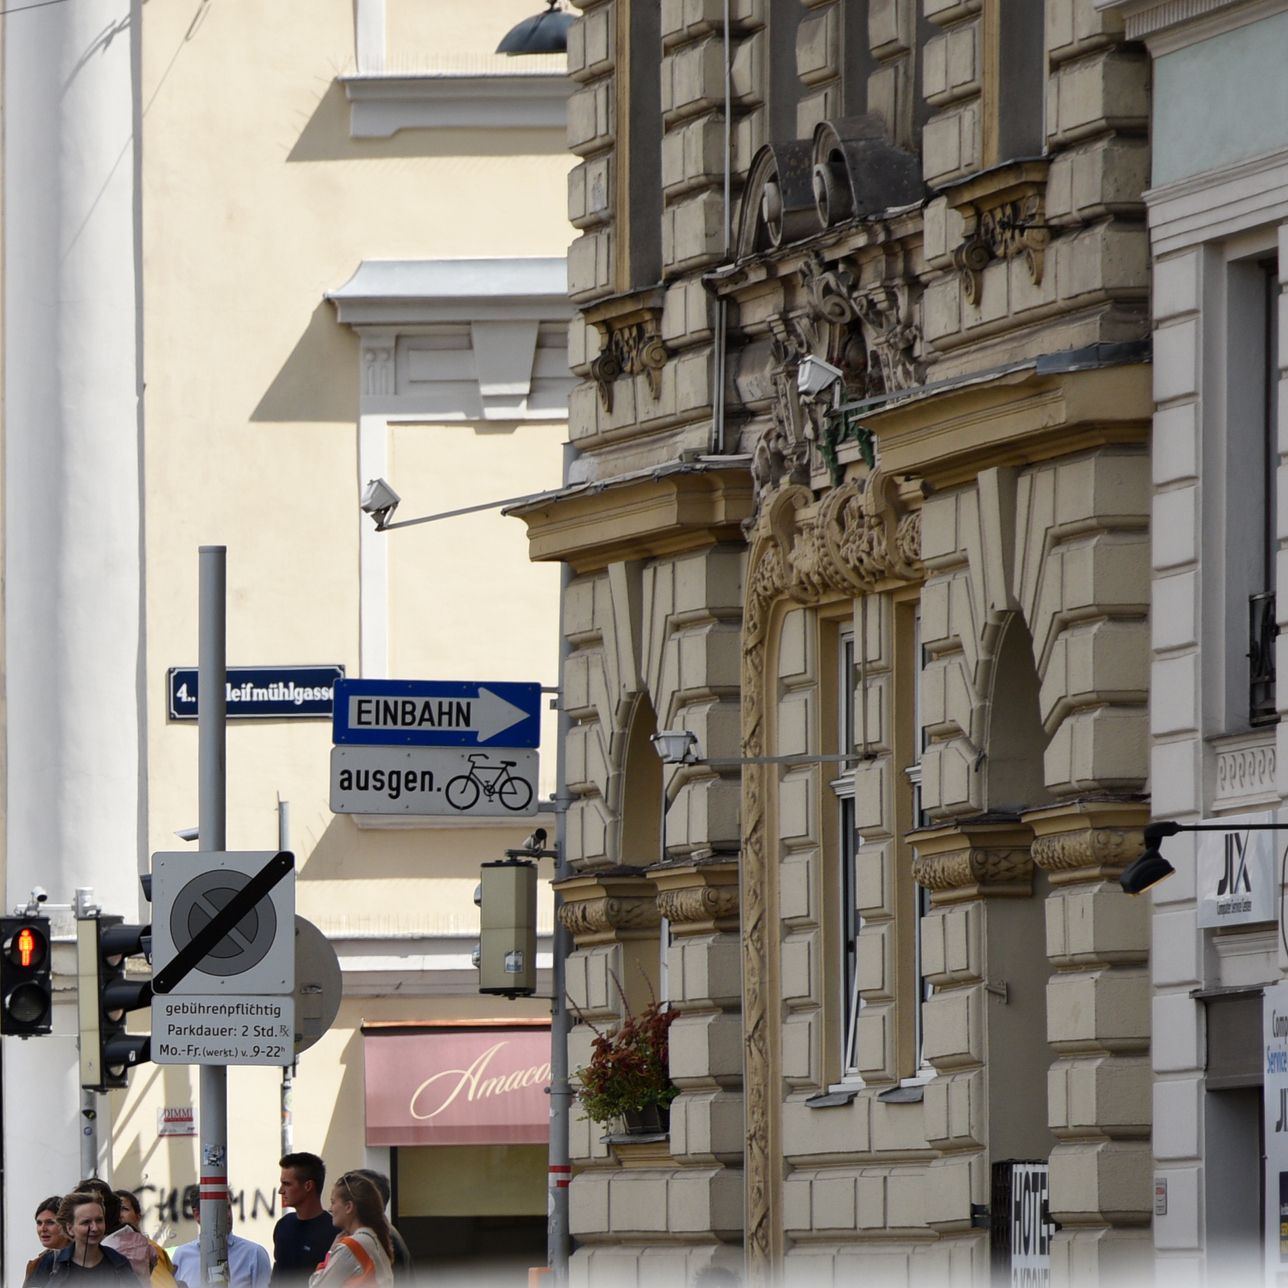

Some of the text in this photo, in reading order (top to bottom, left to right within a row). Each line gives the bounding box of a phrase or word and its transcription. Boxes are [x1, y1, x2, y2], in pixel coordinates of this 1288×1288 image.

[225, 681, 334, 705] leifmühlgass
[356, 699, 472, 727] EINBAHN
[339, 768, 442, 800] ausgen.
[1217, 829, 1252, 896] JIX
[165, 1002, 281, 1018] gebührenpflichtig
[167, 1023, 278, 1038] Parkdauer: 2 Std.
[409, 1040, 554, 1120] Amaco
[1275, 1087, 1288, 1133] JI
